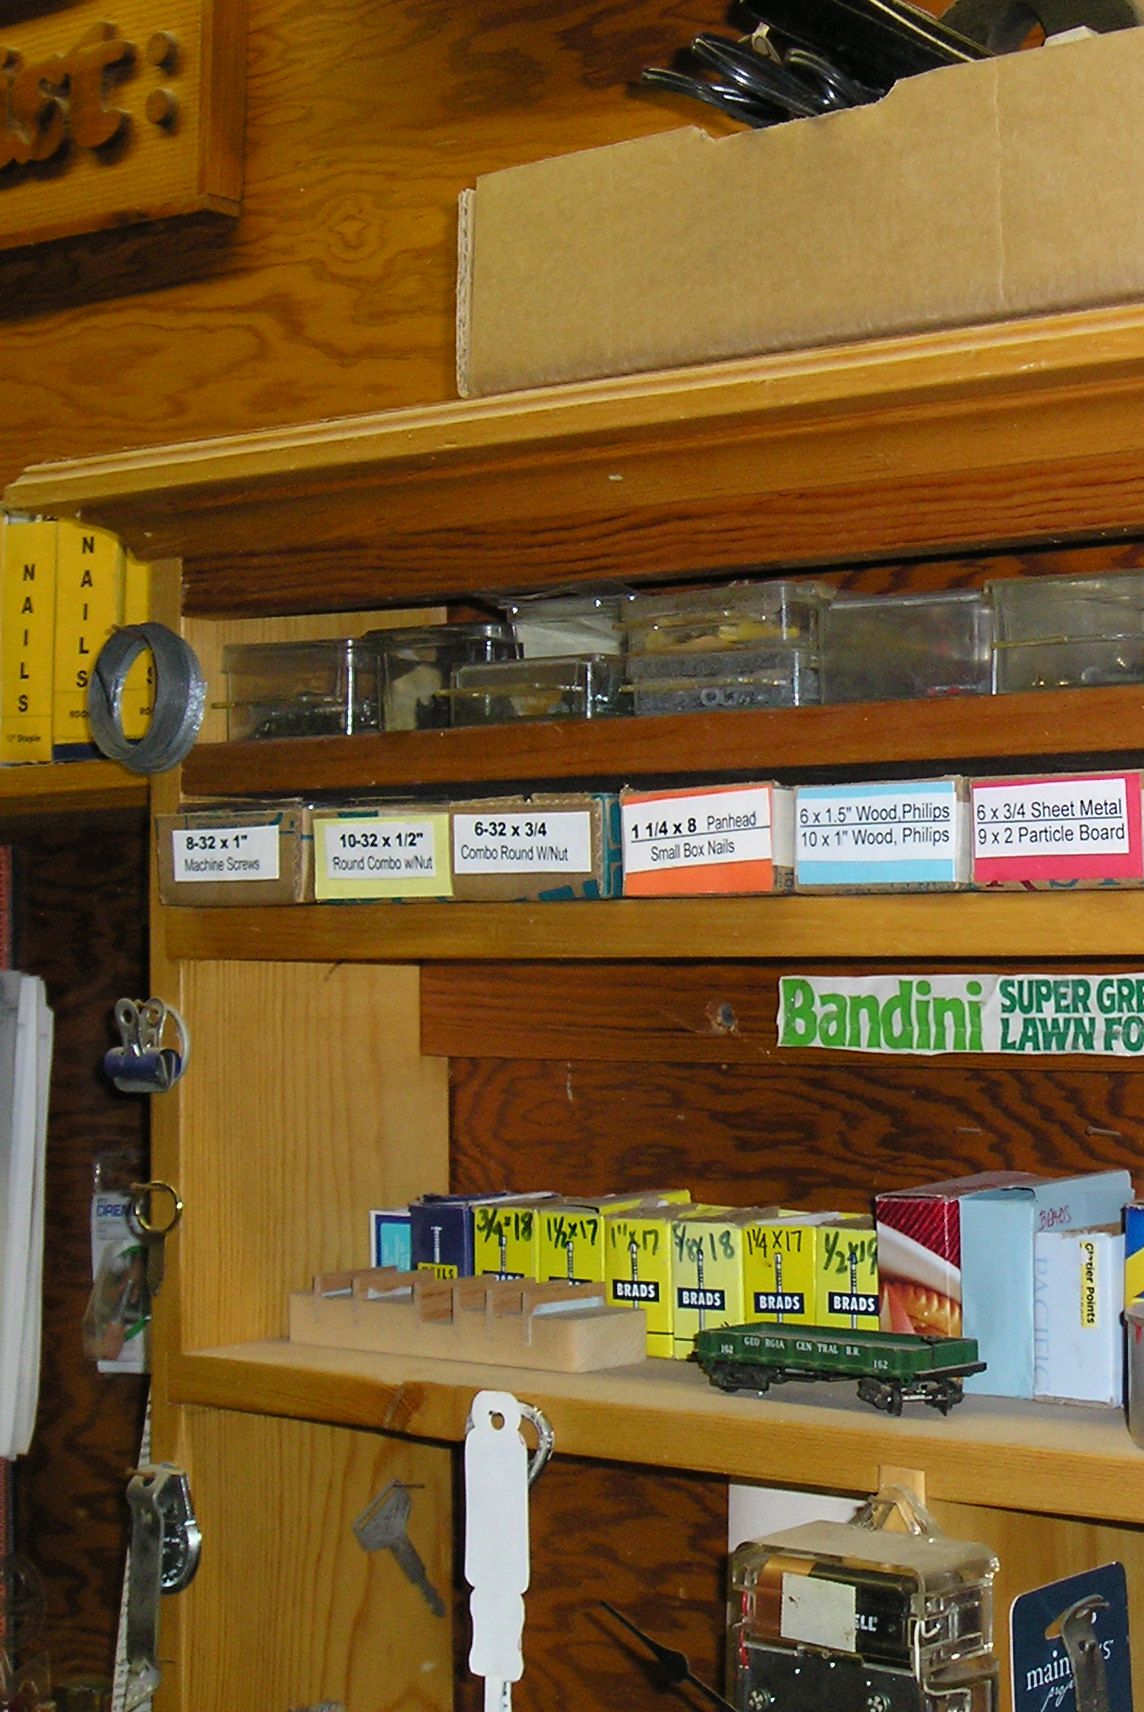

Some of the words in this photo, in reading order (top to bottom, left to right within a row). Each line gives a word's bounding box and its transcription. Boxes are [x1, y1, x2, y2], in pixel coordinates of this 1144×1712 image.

[18, 564, 36, 713] NAILS
[800, 808, 809, 824] 6
[812, 811, 822, 823] x
[825, 805, 853, 823] 1.5"
[977, 806, 986, 820] 6
[990, 809, 999, 820] x
[1003, 803, 1026, 820] 3/4
[1031, 801, 1077, 819] Sheet
[1080, 798, 1122, 817] Metal
[474, 823, 507, 837] 6-32
[511, 826, 520, 836] x
[524, 822, 547, 836] 3/4
[631, 824, 639, 839] 1
[646, 821, 668, 838] 1/4
[673, 822, 682, 834] x
[687, 818, 697, 833] 8
[707, 811, 757, 831] Panhead
[978, 830, 987, 844] 9
[990, 833, 1000, 843] x
[1004, 828, 1014, 843] 2
[1018, 825, 1076, 843] Particle
[1080, 823, 1125, 841] Board
[185, 835, 216, 851] 8-32
[220, 839, 229, 849] x
[234, 835, 248, 849] 1"
[339, 833, 378, 848] 10-32
[382, 837, 391, 847] x
[395, 832, 424, 847] 1/2"
[801, 831, 817, 847] 10
[821, 834, 830, 846] x
[852, 828, 897, 845] Wood,
[902, 827, 950, 846] Philips
[461, 845, 498, 860] Combo
[500, 845, 534, 860] Round
[537, 845, 568, 861] W/Nut
[651, 843, 681, 862] Small
[684, 842, 705, 858] Box
[708, 838, 735, 854] Nails
[184, 856, 224, 872] Machine
[227, 856, 260, 870] Screws
[333, 856, 366, 871] Round
[368, 855, 401, 870] Combo
[403, 854, 433, 870] w/Nut
[780, 979, 984, 1052] Bandini
[1000, 979, 1091, 1015] SUPER
[1000, 1017, 1097, 1051] LAWN
[616, 1283, 656, 1299] BRADS
[682, 1291, 721, 1307] BRADS
[759, 1295, 800, 1311] BRADS
[833, 1296, 876, 1312] BRADS
[1086, 1286, 1096, 1324] Points
[873, 1359, 889, 1370] 162
